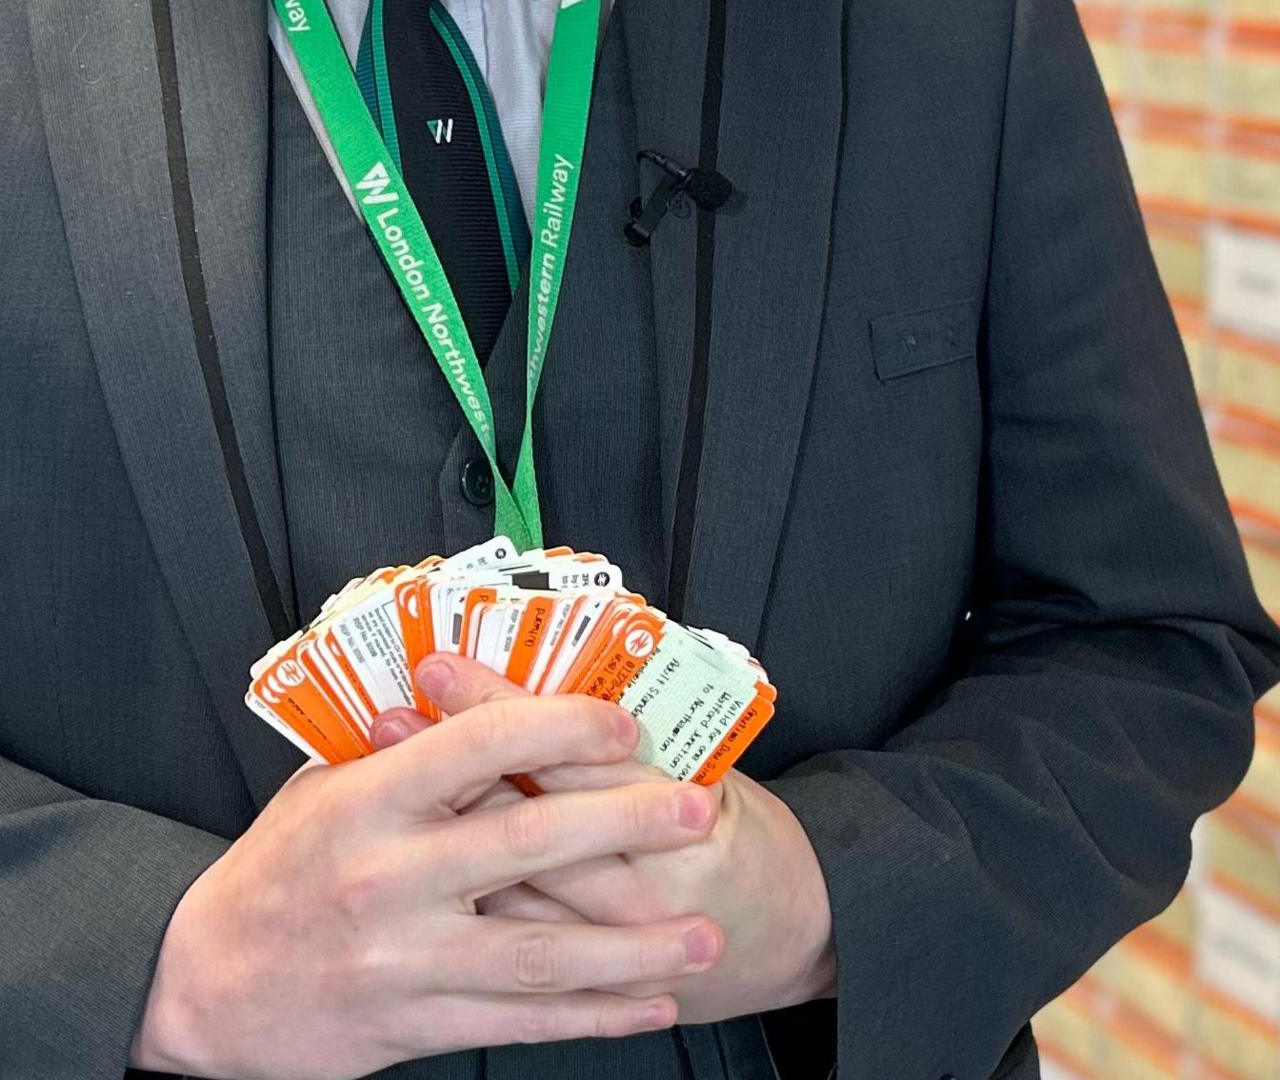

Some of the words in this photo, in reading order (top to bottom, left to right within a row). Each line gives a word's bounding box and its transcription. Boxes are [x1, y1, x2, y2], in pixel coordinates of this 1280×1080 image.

[541, 154, 575, 248] Railway
[376, 207, 431, 301] London
[524, 607, 546, 648] Outward
[655, 657, 682, 687] Adult
[701, 682, 716, 697] to
[629, 685, 661, 721] Standa
[698, 690, 734, 730] Watford
[718, 698, 745, 728] Valid
[657, 697, 706, 755] Northampton
[706, 727, 723, 745] for
[667, 729, 704, 771] Junction
[691, 743, 708, 763] one
[694, 760, 717, 785] Sing
